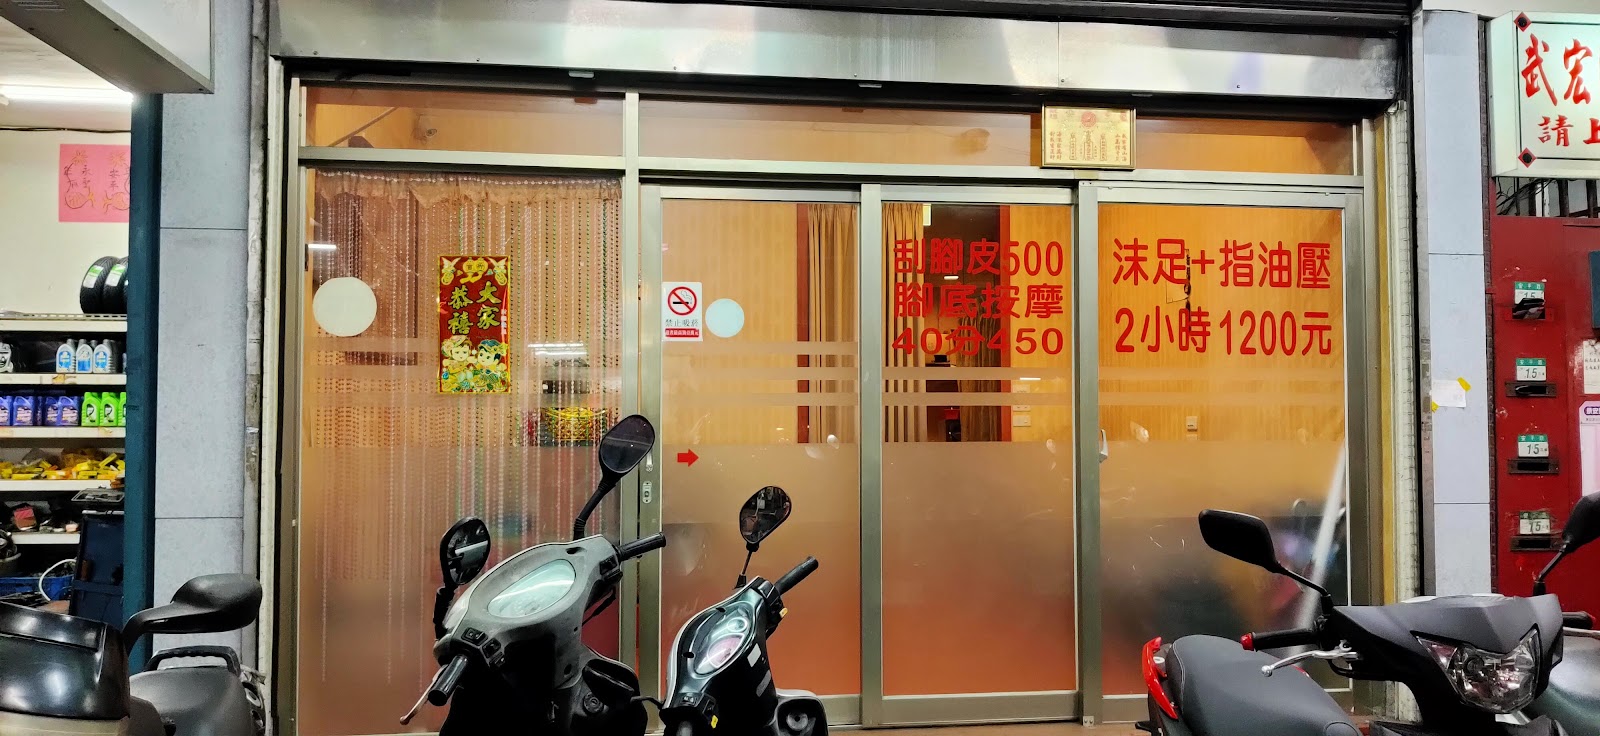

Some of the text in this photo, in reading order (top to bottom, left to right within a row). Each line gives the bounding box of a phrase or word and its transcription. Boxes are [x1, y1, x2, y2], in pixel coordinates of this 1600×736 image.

[1521, 33, 1593, 107] 武宏
[893, 238, 1064, 276] 刮腳皮500
[447, 285, 474, 335] 恭禧
[476, 281, 502, 330] 大家
[894, 282, 1064, 319] 腳底按摩
[891, 325, 1064, 356] 40分450
